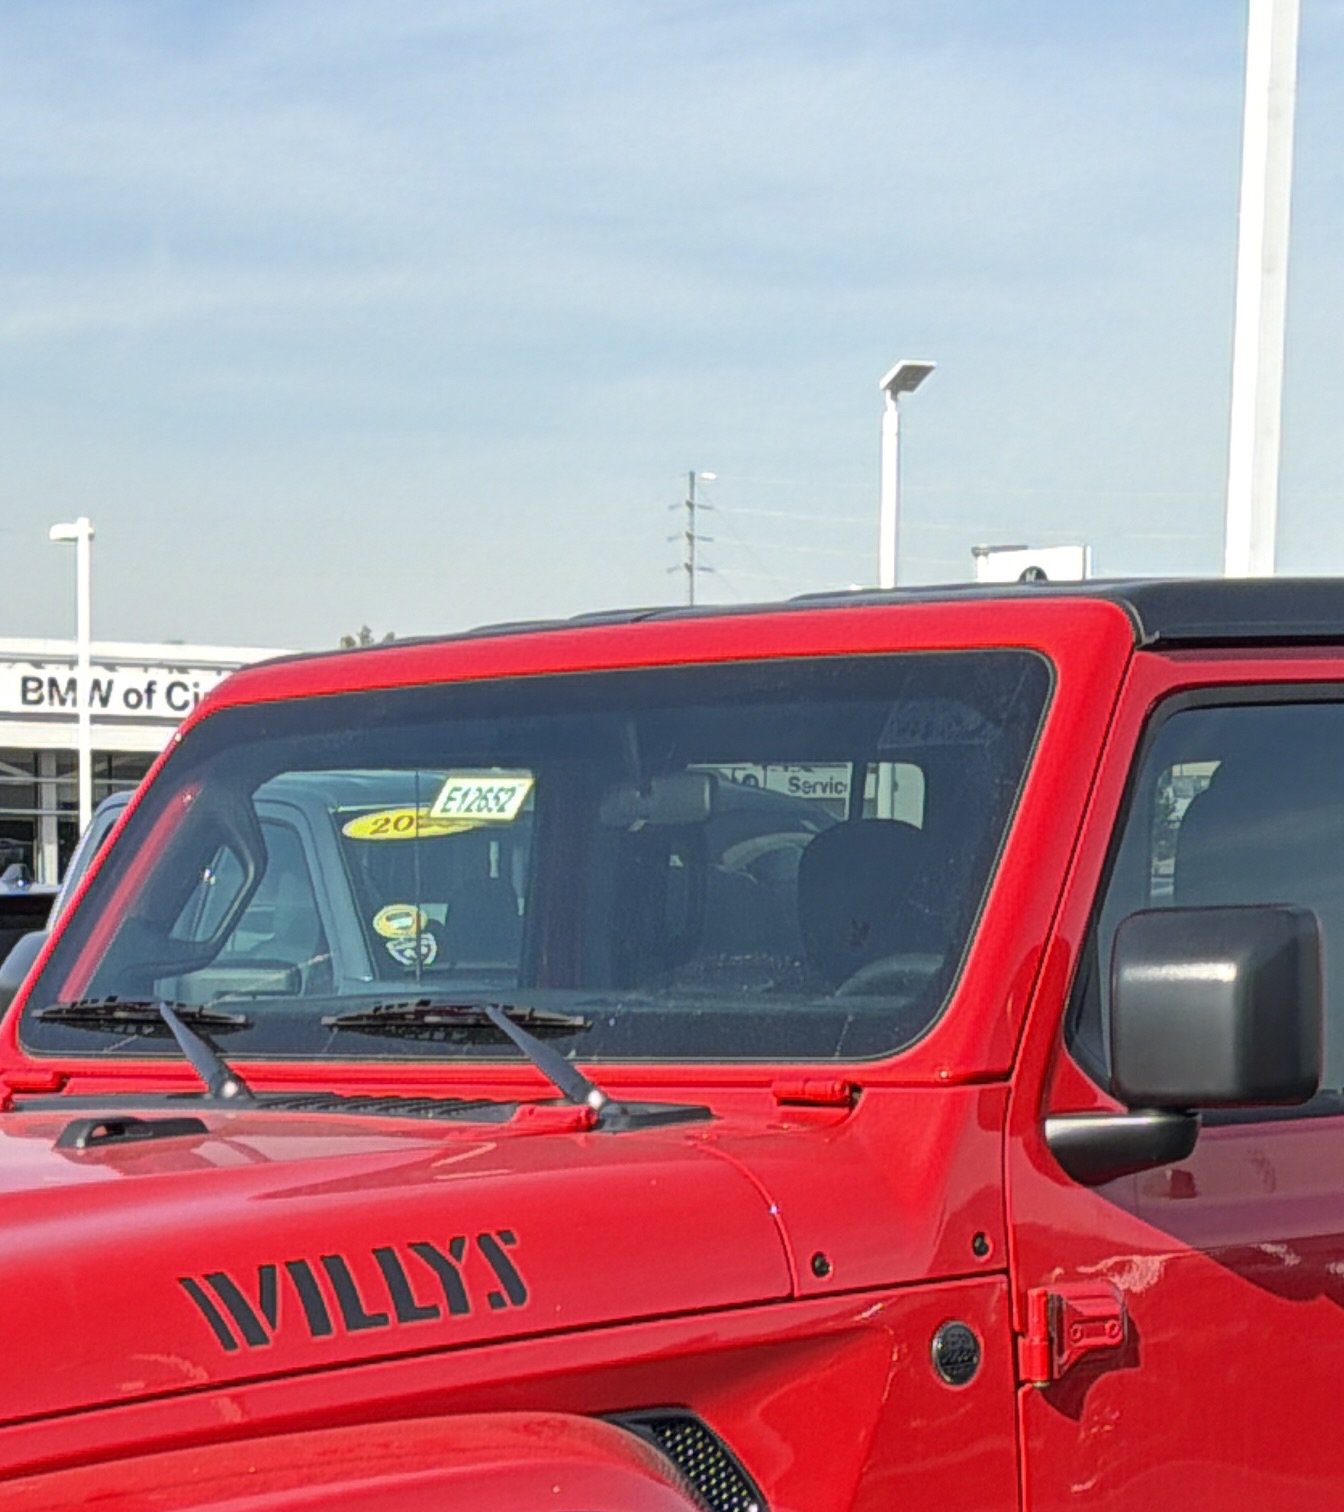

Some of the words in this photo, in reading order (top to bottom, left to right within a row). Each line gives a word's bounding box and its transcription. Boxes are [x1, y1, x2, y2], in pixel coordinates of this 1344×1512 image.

[21, 675, 114, 708] BMW
[122, 680, 157, 710] of
[166, 681, 209, 712] Ci
[440, 785, 517, 815] E12652
[787, 775, 849, 796] Servic
[177, 1228, 529, 1352] WILLYS
